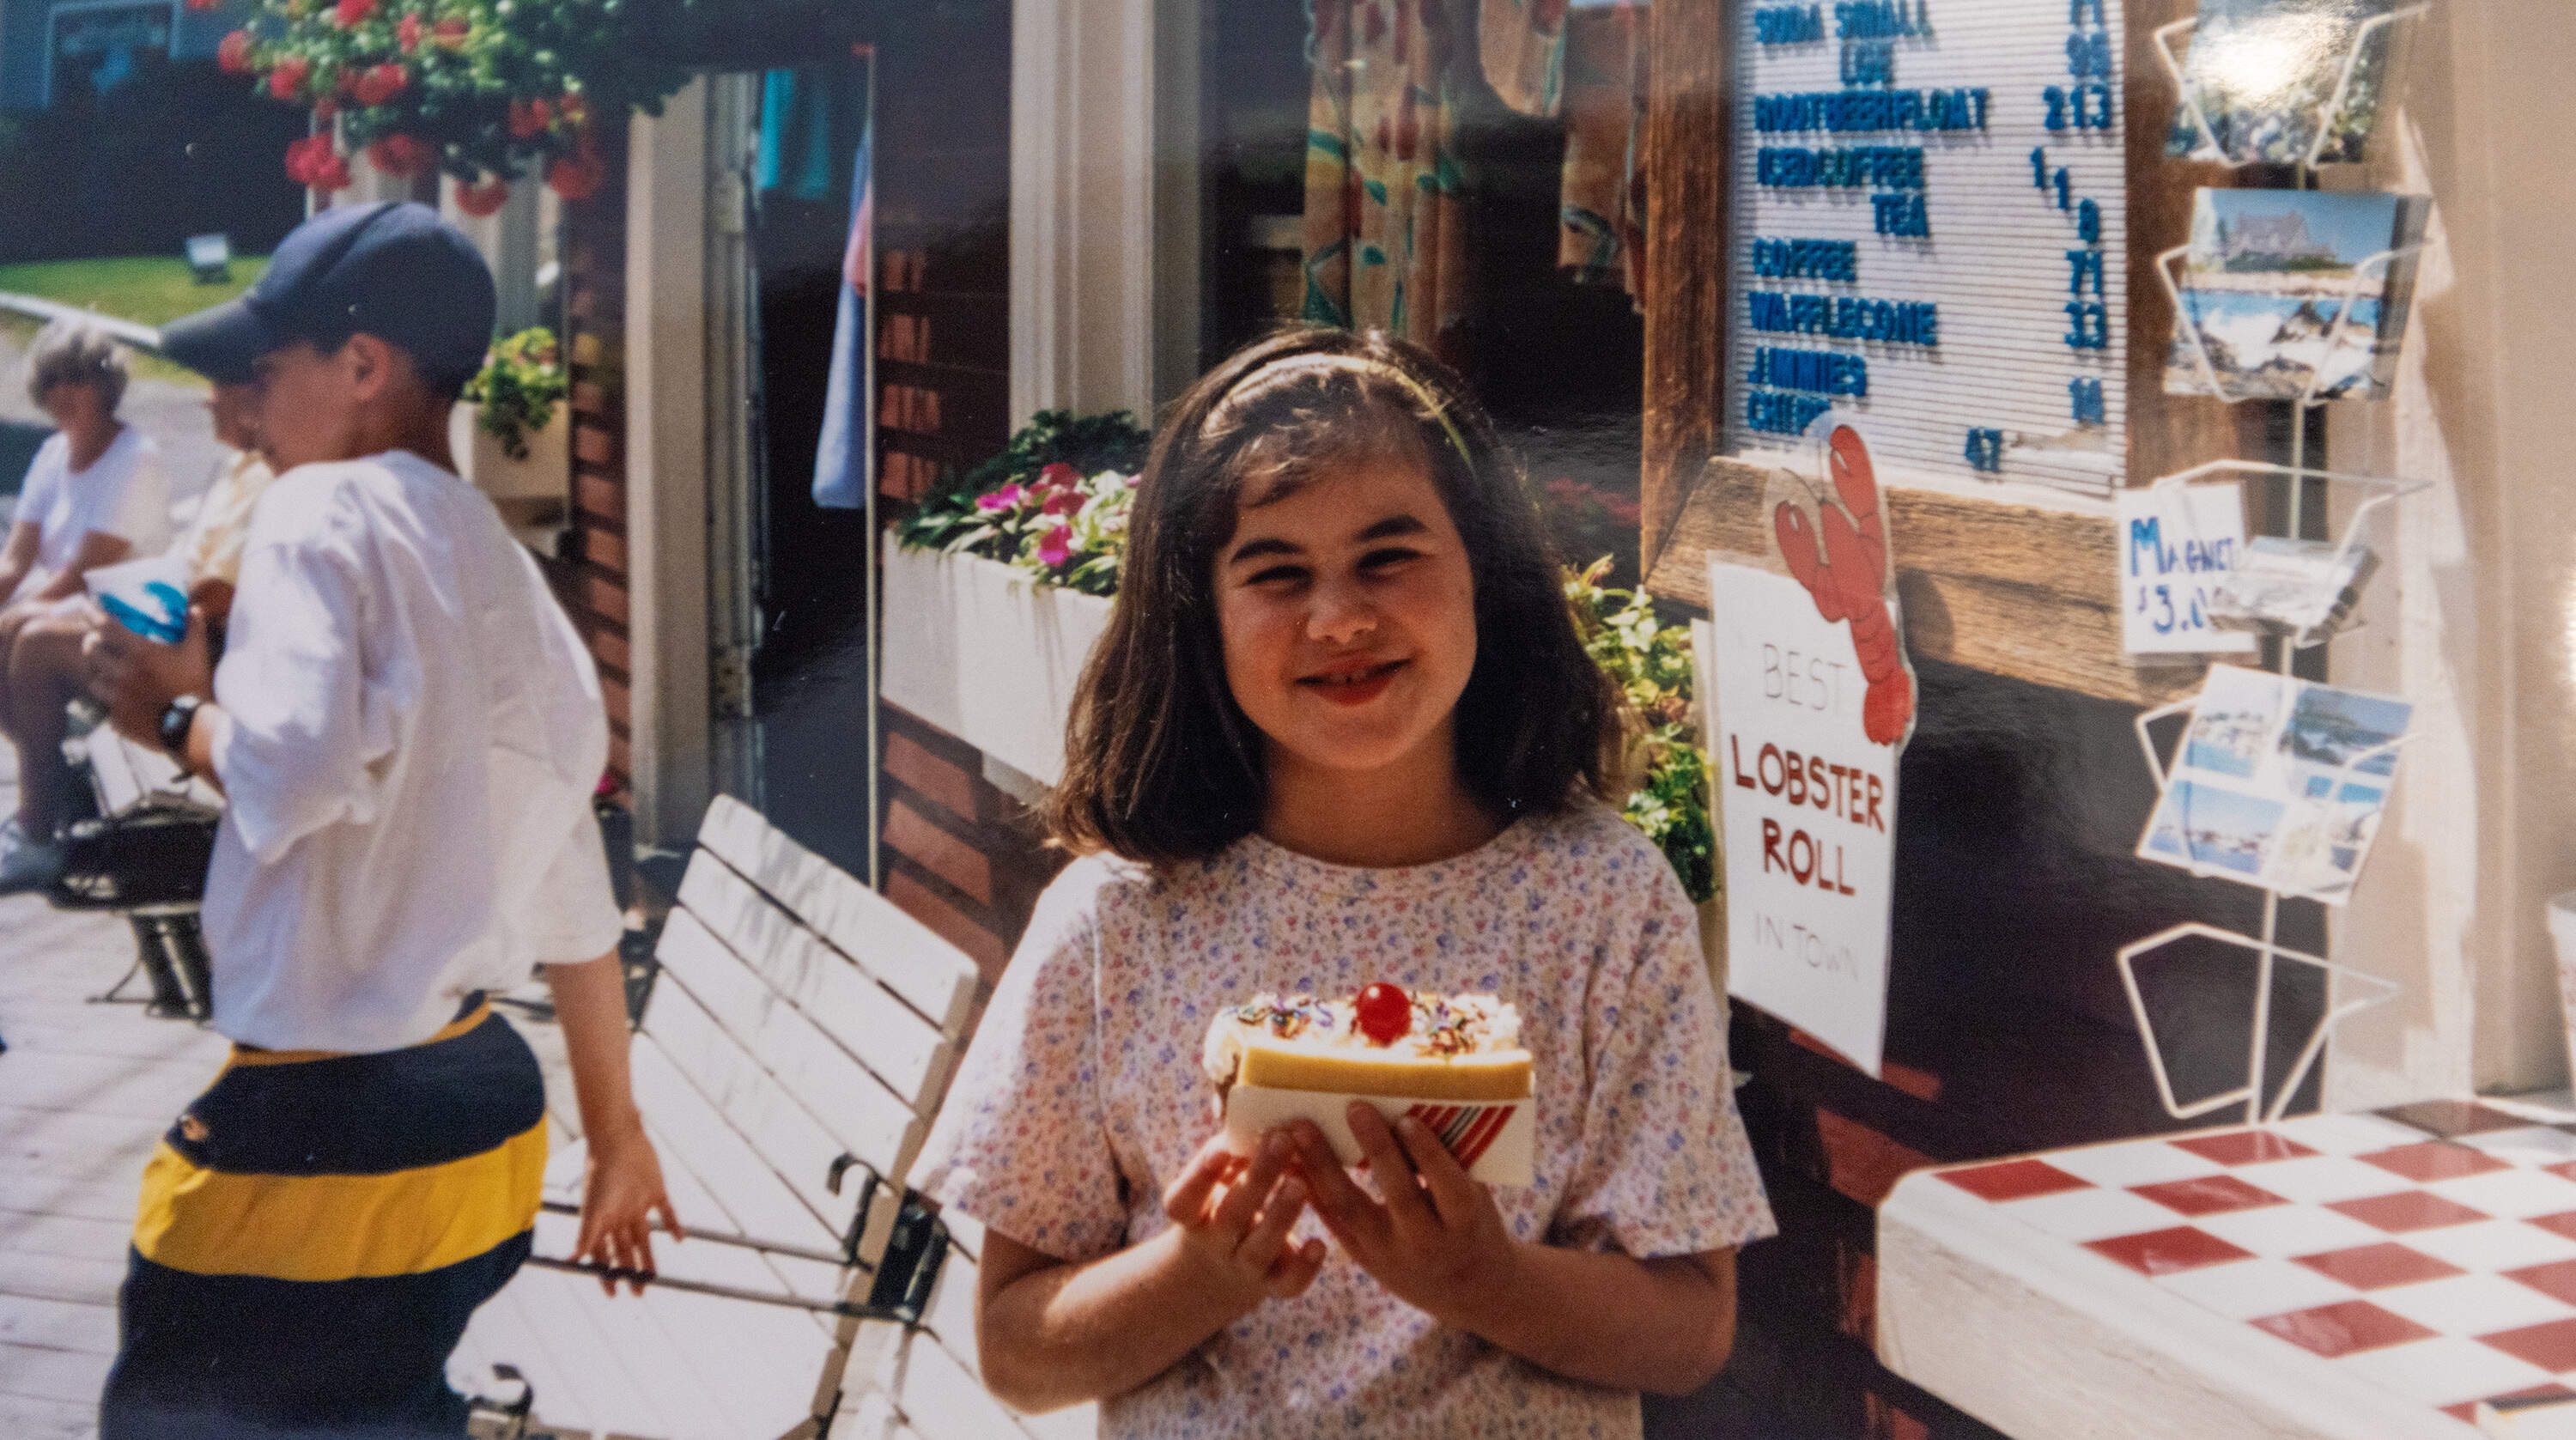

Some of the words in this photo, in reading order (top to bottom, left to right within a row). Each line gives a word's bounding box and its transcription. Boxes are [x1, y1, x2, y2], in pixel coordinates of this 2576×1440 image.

[1869, 192, 1929, 236] TEA
[1751, 237, 1855, 282] COFFEE
[1747, 347, 1867, 397] JIMMIES
[1763, 642, 1848, 714] BEST
[1730, 733, 1885, 834] LOBSTER
[1762, 817, 1856, 896] ROLL
[1754, 910, 1784, 951] IN
